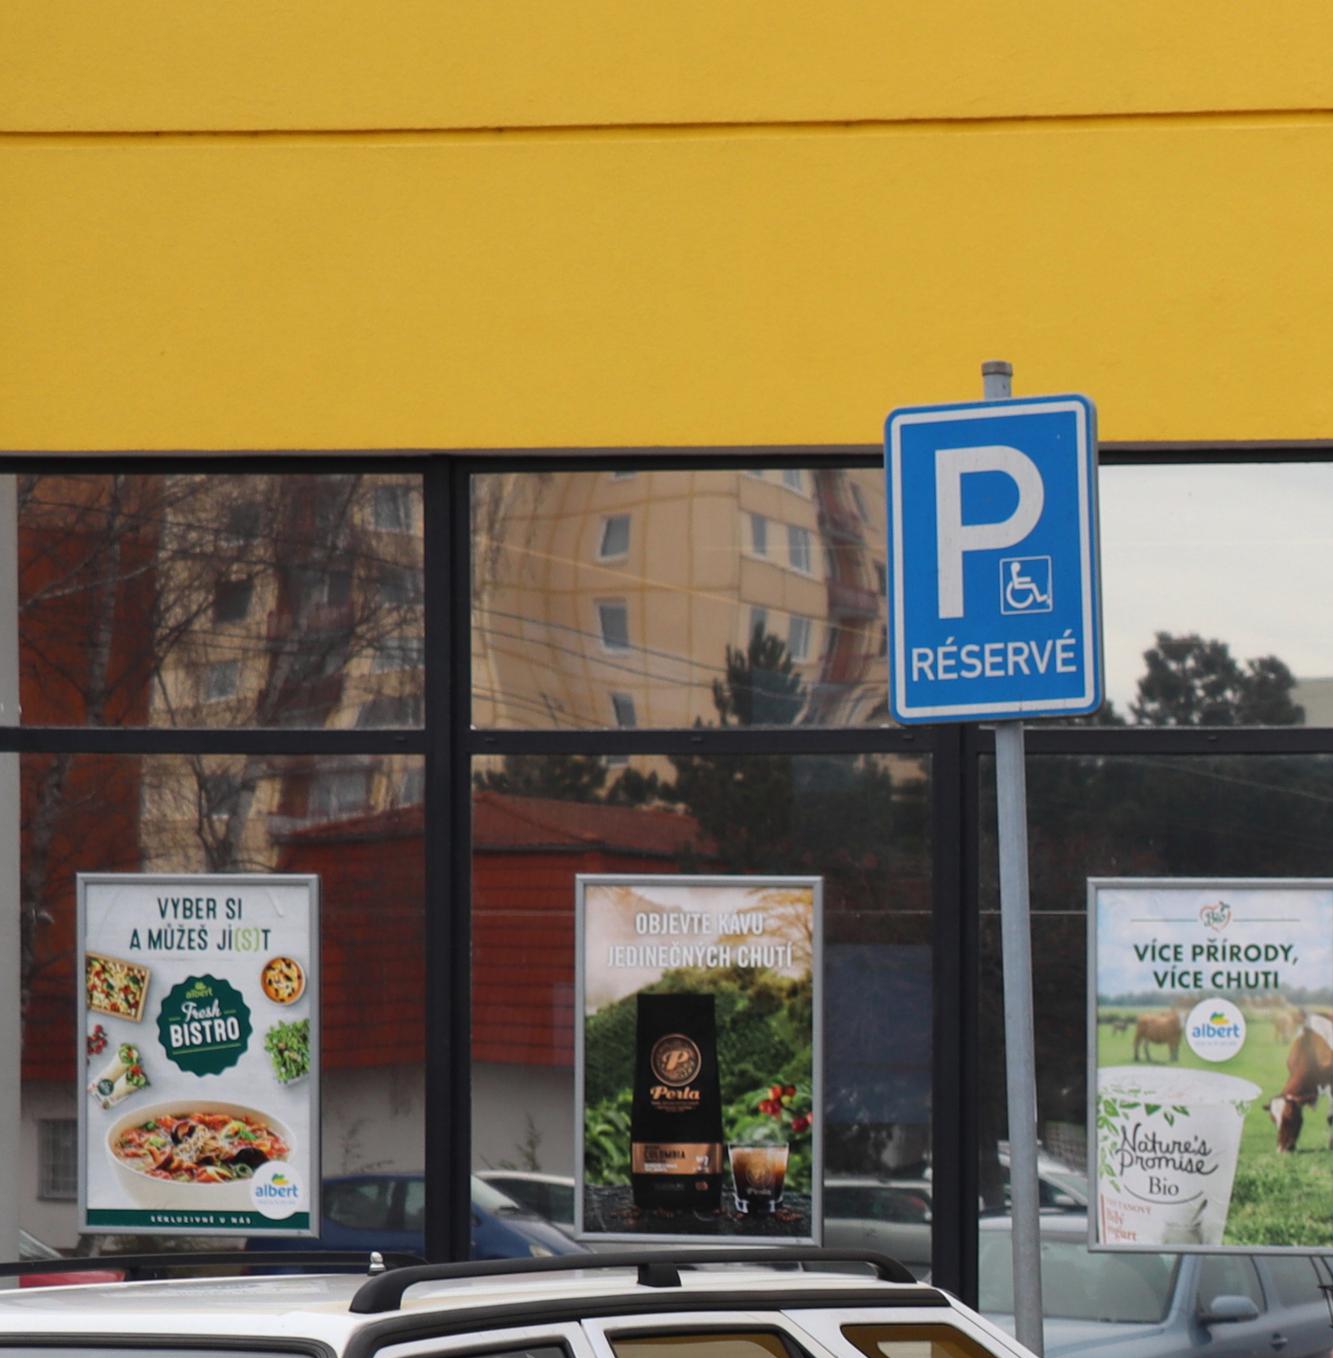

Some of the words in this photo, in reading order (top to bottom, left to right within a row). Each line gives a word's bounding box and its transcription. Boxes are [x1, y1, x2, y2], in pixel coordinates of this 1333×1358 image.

[934, 445, 1045, 620] P
[912, 629, 1077, 682] RÉSERVÉ
[157, 896, 222, 921] VYBER
[226, 896, 243, 920] SI
[635, 912, 712, 935] OBJEVTE
[129, 929, 141, 950] A
[147, 923, 209, 951] MŮŽEŠ
[608, 941, 731, 968] JEDINEČNÝCH
[737, 942, 793, 968] CHUTÍ
[1132, 938, 1184, 963] VÍCE
[1191, 937, 1300, 966] PŘÍRODY,
[1153, 965, 1204, 990] VÍCE
[1211, 971, 1280, 990] CHUTI
[181, 998, 222, 1022] Fresh
[169, 1016, 240, 1048] BISTRO
[1191, 1023, 1241, 1038] albert
[649, 1086, 702, 1100] Perla
[1120, 1122, 1213, 1157] Nature's
[1114, 1148, 1220, 1177] Promise
[255, 1184, 299, 1198] albert
[1148, 1176, 1180, 1197] Bio
